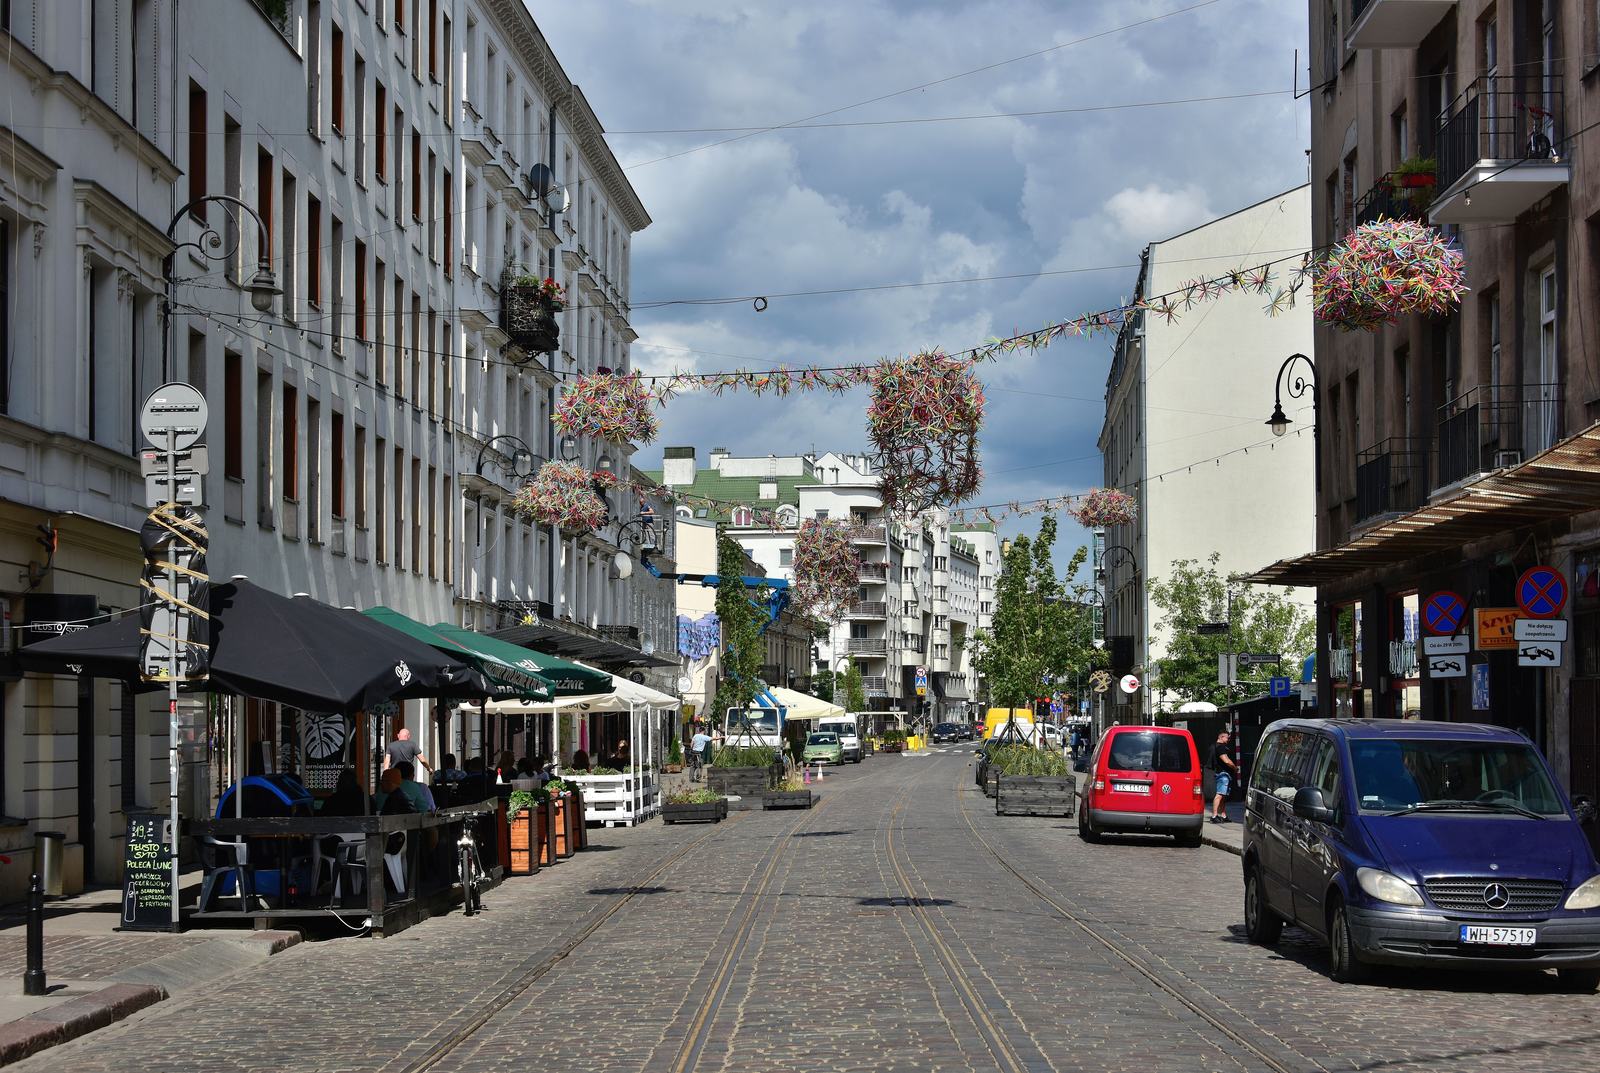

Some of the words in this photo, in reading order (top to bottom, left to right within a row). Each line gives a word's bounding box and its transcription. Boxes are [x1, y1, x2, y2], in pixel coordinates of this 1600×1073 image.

[1274, 679, 1285, 694] P
[127, 860, 151, 869] POLECA
[152, 859, 172, 869] LUNC
[1469, 927, 1488, 941] WH
[1493, 928, 1534, 942] 57519
